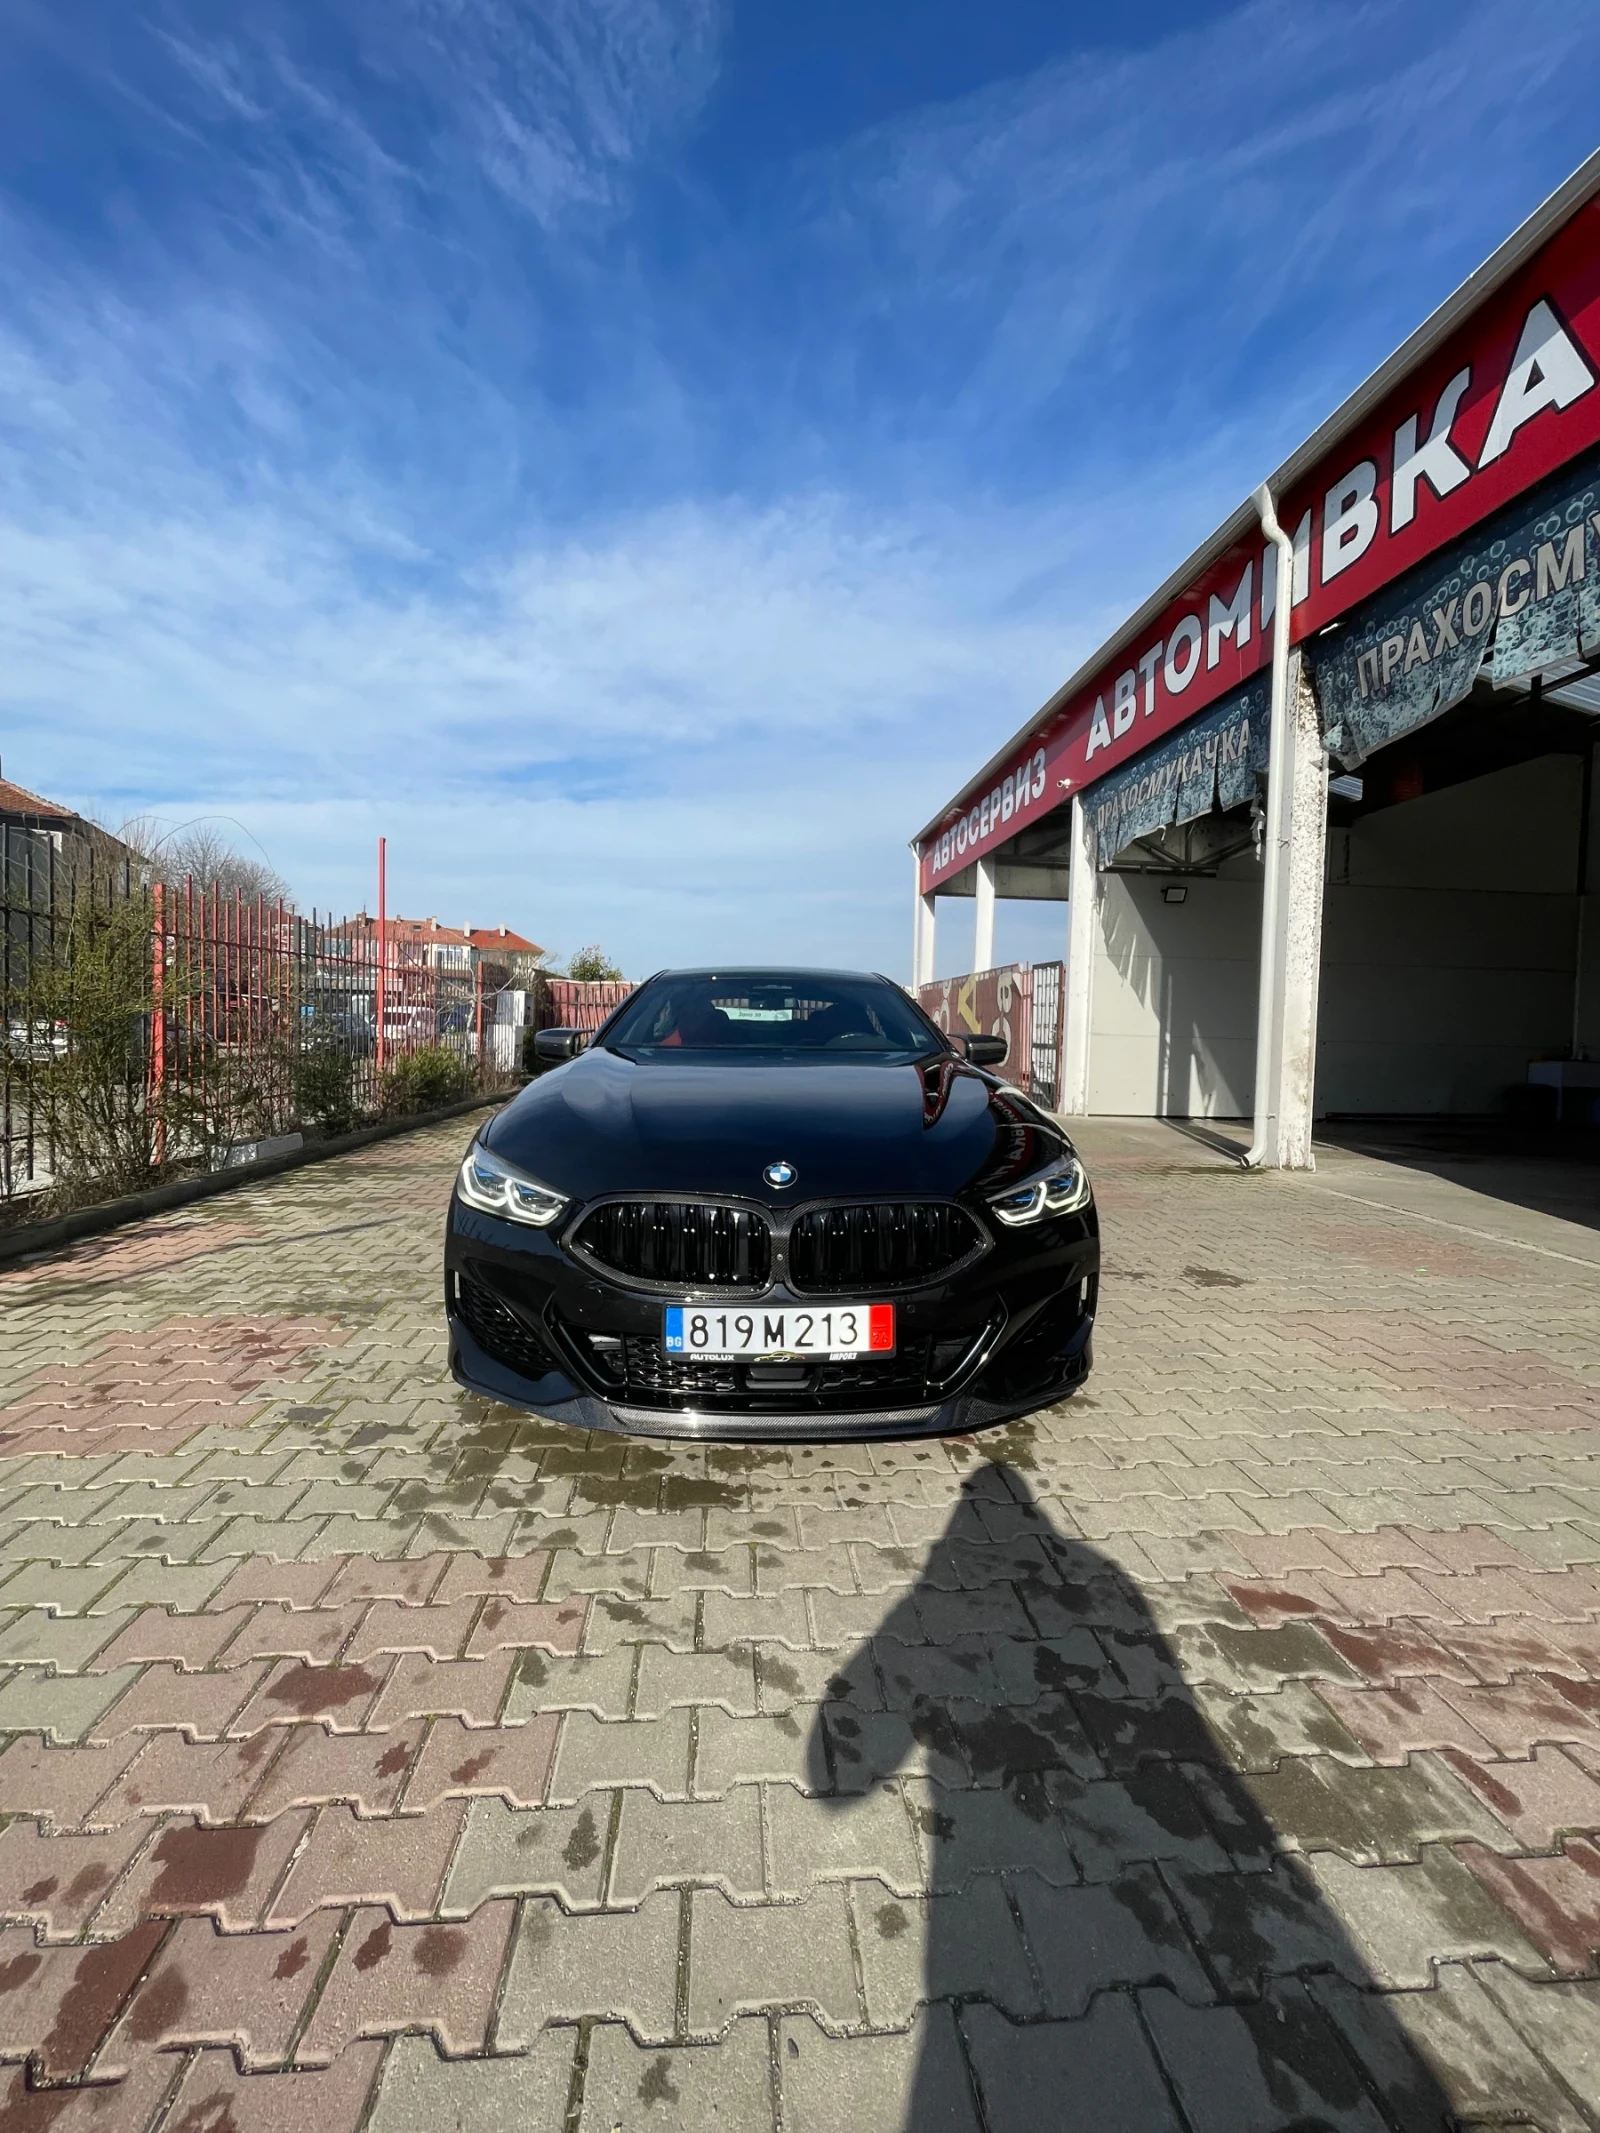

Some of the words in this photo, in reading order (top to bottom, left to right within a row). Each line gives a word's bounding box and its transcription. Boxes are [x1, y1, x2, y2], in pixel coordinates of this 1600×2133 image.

[1356, 512, 1600, 699] ПРАХОСМ
[1097, 718, 1251, 830] ПРАХОСМУКАЧКА
[932, 747, 1046, 875] АВТОСЕРВИЗ
[666, 1336, 682, 1347] BG
[690, 1353, 735, 1361] AUTOLUX
[872, 1332, 889, 1345] 26
